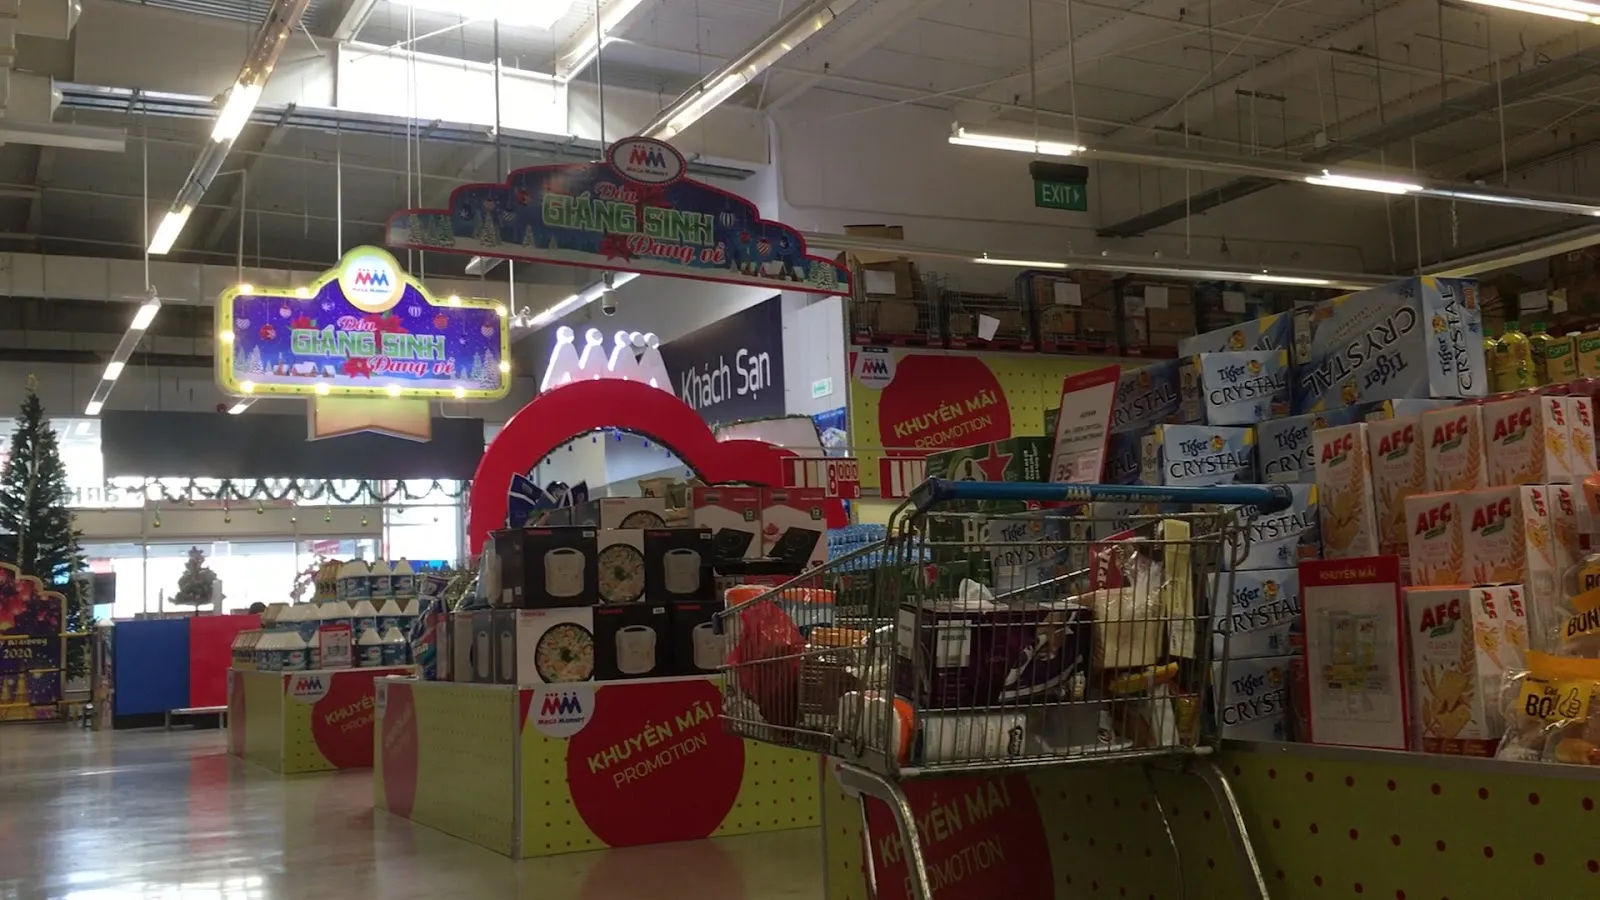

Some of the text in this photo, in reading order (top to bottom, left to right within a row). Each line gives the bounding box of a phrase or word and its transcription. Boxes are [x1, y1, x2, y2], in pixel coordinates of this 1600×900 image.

[1042, 184, 1071, 204] EXIT
[542, 191, 714, 245] GIÁNG SINH
[290, 324, 446, 361] GIÁNG SINH
[1302, 306, 1417, 397] CRYSTAL
[1441, 285, 1473, 391] CRYSTAL
[1363, 351, 1409, 390] Tiger
[1438, 338, 1452, 375] Tiger
[681, 348, 771, 411] Khách Sạn
[1210, 373, 1287, 406] CRYSTAL
[1217, 365, 1245, 382] Tiger
[964, 389, 998, 413] MÃI
[1550, 399, 1566, 426] AFC
[1576, 399, 1592, 427] AFC
[914, 415, 993, 449] PROMOTION
[1275, 426, 1308, 450] Tiger
[1431, 416, 1469, 448] AFC
[1492, 406, 1533, 441] AFC
[1179, 439, 1209, 457] Tiger
[1321, 432, 1353, 463] AFC
[1378, 424, 1415, 457] AFC
[1170, 450, 1251, 478] CRYSTAL
[1416, 502, 1452, 535] AFC
[1471, 497, 1511, 532] AFC
[1532, 488, 1547, 517] AFC
[1420, 599, 1461, 632] AFC
[1482, 590, 1498, 619] AFC
[1509, 588, 1524, 617] AFC
[1232, 674, 1264, 696] Tiger
[587, 699, 715, 774] KHUYẾN MÃI
[612, 732, 708, 789] PROMOTION
